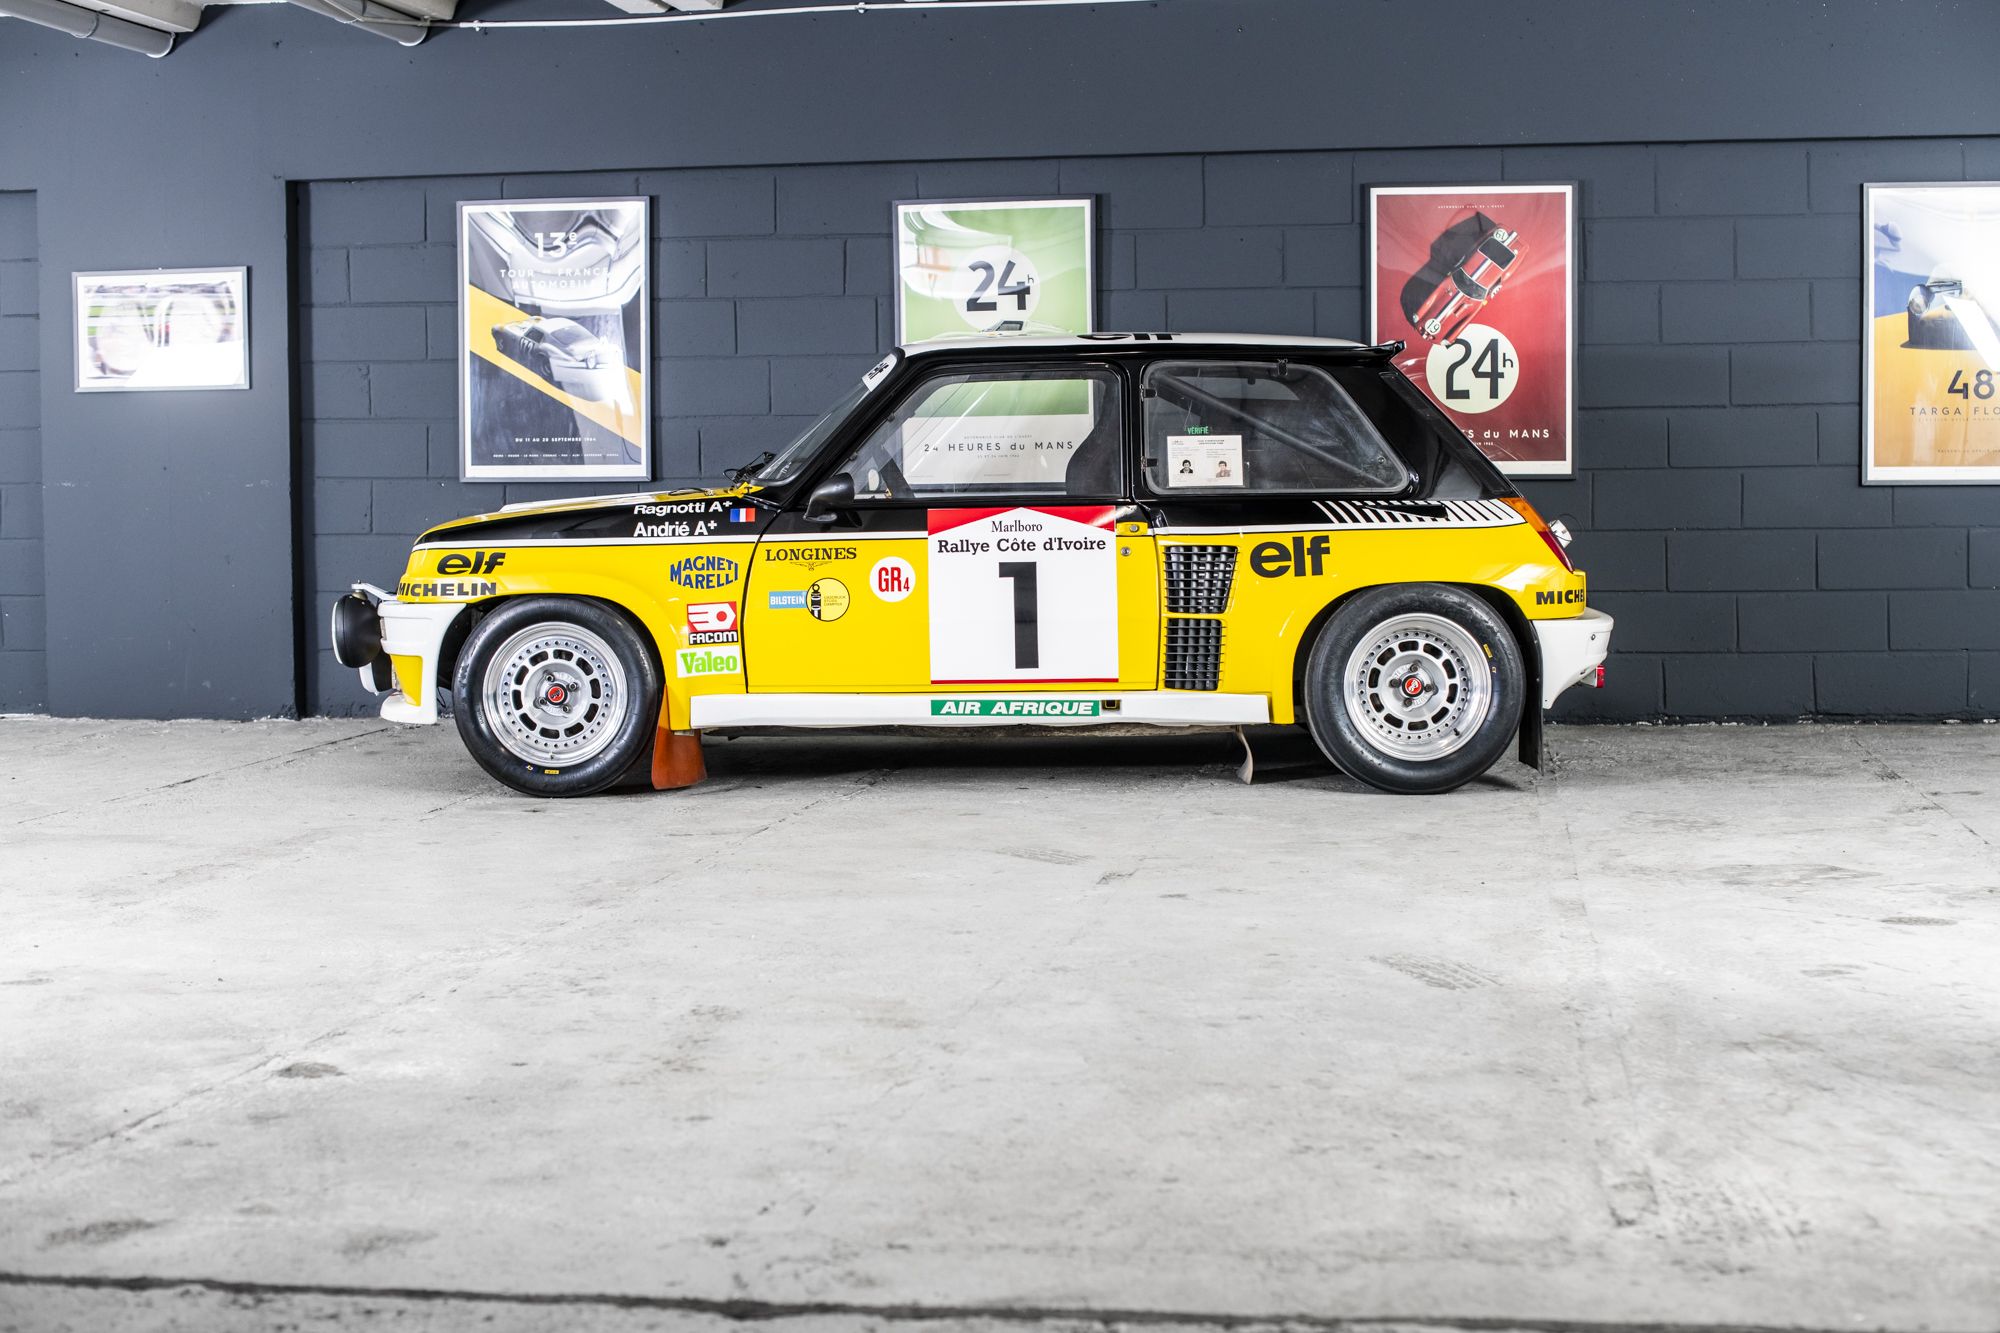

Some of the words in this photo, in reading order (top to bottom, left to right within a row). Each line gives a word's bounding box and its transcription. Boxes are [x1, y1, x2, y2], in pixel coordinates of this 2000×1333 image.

[500, 269, 534, 278] TOUR
[1910, 407, 1962, 416] TARGA
[1483, 429, 1500, 438] du
[1509, 429, 1550, 439] MANS
[948, 442, 1001, 452] HEURES
[1010, 442, 1025, 451] du
[1034, 441, 1074, 451] MANS
[633, 502, 706, 517] Ragnotti
[633, 521, 690, 538] Andrié
[991, 520, 1043, 533] Marlboro
[938, 539, 990, 556] Rallye
[996, 537, 1037, 552] Côte
[1043, 536, 1107, 551] d'Ivoire
[765, 547, 857, 562] LONGINES
[1249, 535, 1331, 579] elf
[436, 551, 507, 575] elf
[670, 556, 738, 580] MAGNETI
[670, 567, 738, 590] MARELLI
[770, 595, 805, 605] BILSTEIN
[998, 561, 1039, 669] 1
[689, 631, 738, 645] FACOM
[680, 651, 738, 674] Valeo
[940, 701, 982, 715] AIR
[991, 701, 1095, 716] AFRIQUE
